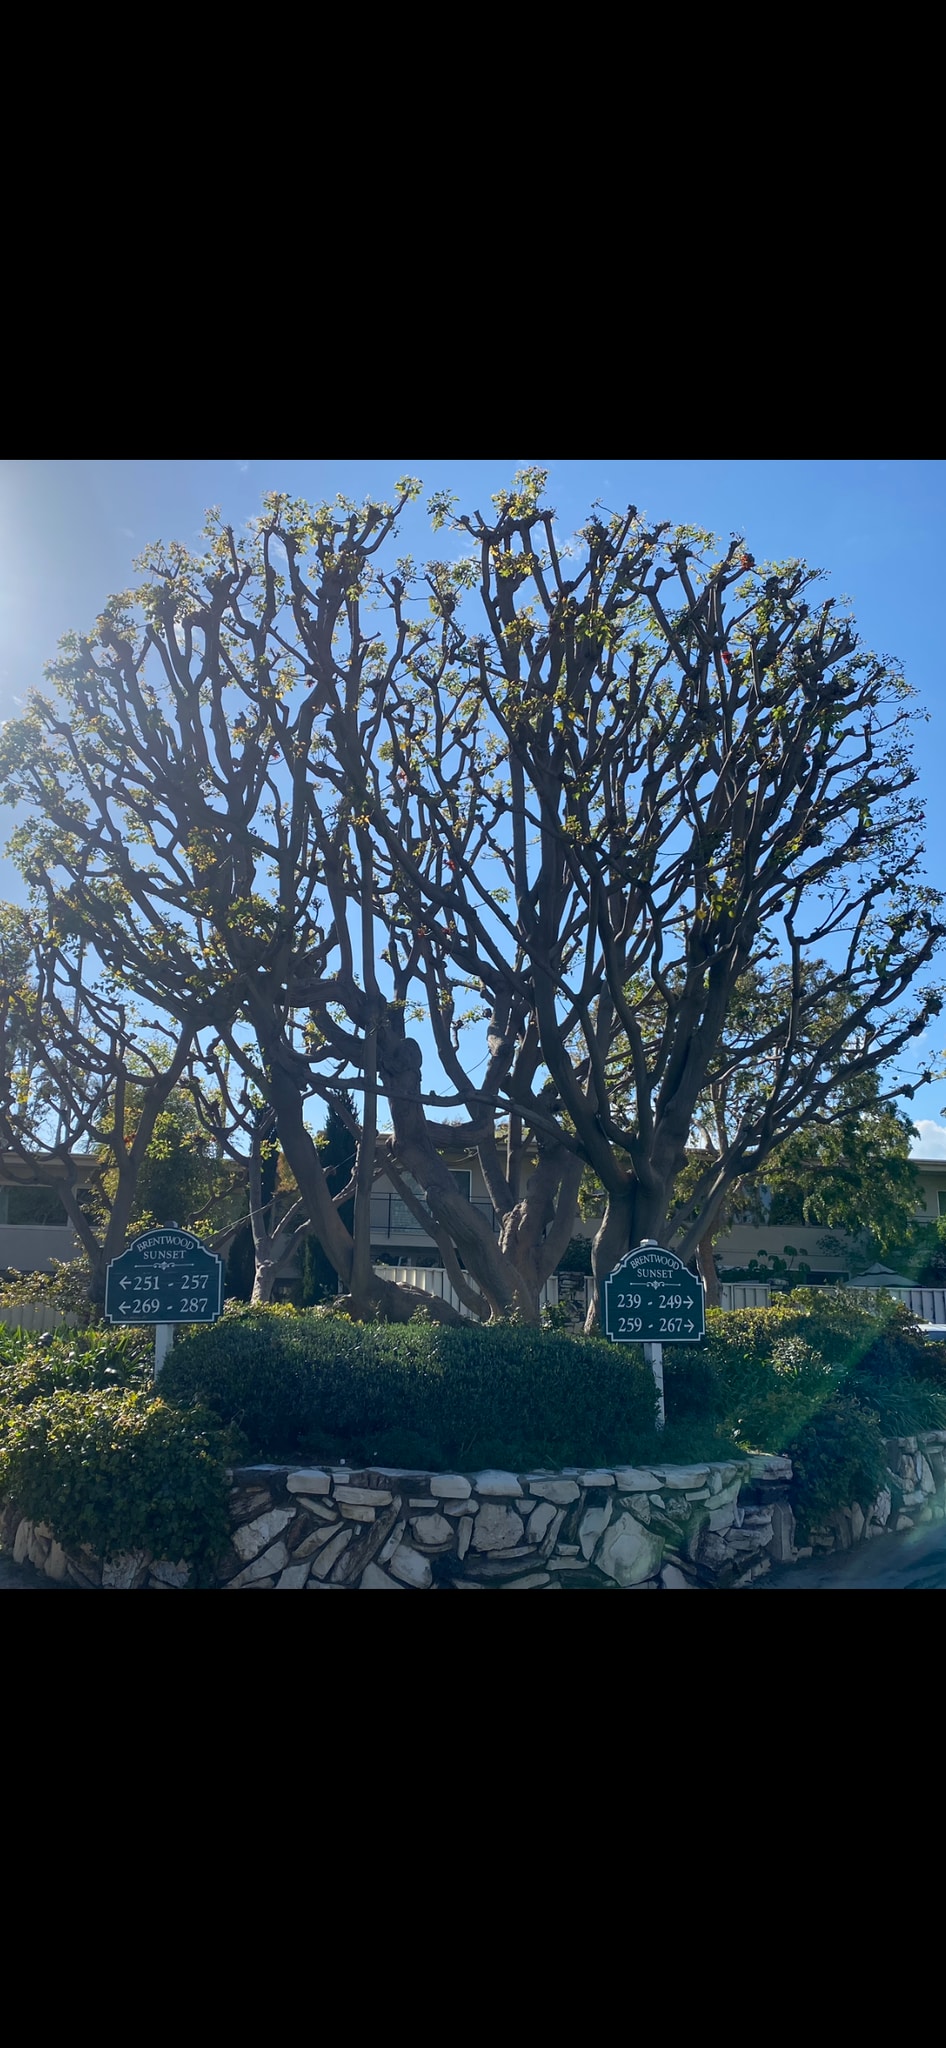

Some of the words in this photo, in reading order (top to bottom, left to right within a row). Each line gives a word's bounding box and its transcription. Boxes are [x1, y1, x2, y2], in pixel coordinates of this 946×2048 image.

[137, 1236, 194, 1252] BRENTWOOD
[143, 1250, 187, 1260] SUNSET
[630, 1254, 680, 1270] BRENTWOOD
[637, 1268, 674, 1279] SUNSET
[133, 1276, 160, 1291] 251
[181, 1274, 209, 1290] 257
[132, 1298, 160, 1314] 269
[180, 1297, 208, 1313] 287
[617, 1293, 642, 1309] 239
[658, 1294, 682, 1309] 249
[618, 1317, 643, 1333] 259
[659, 1317, 683, 1333] 267
